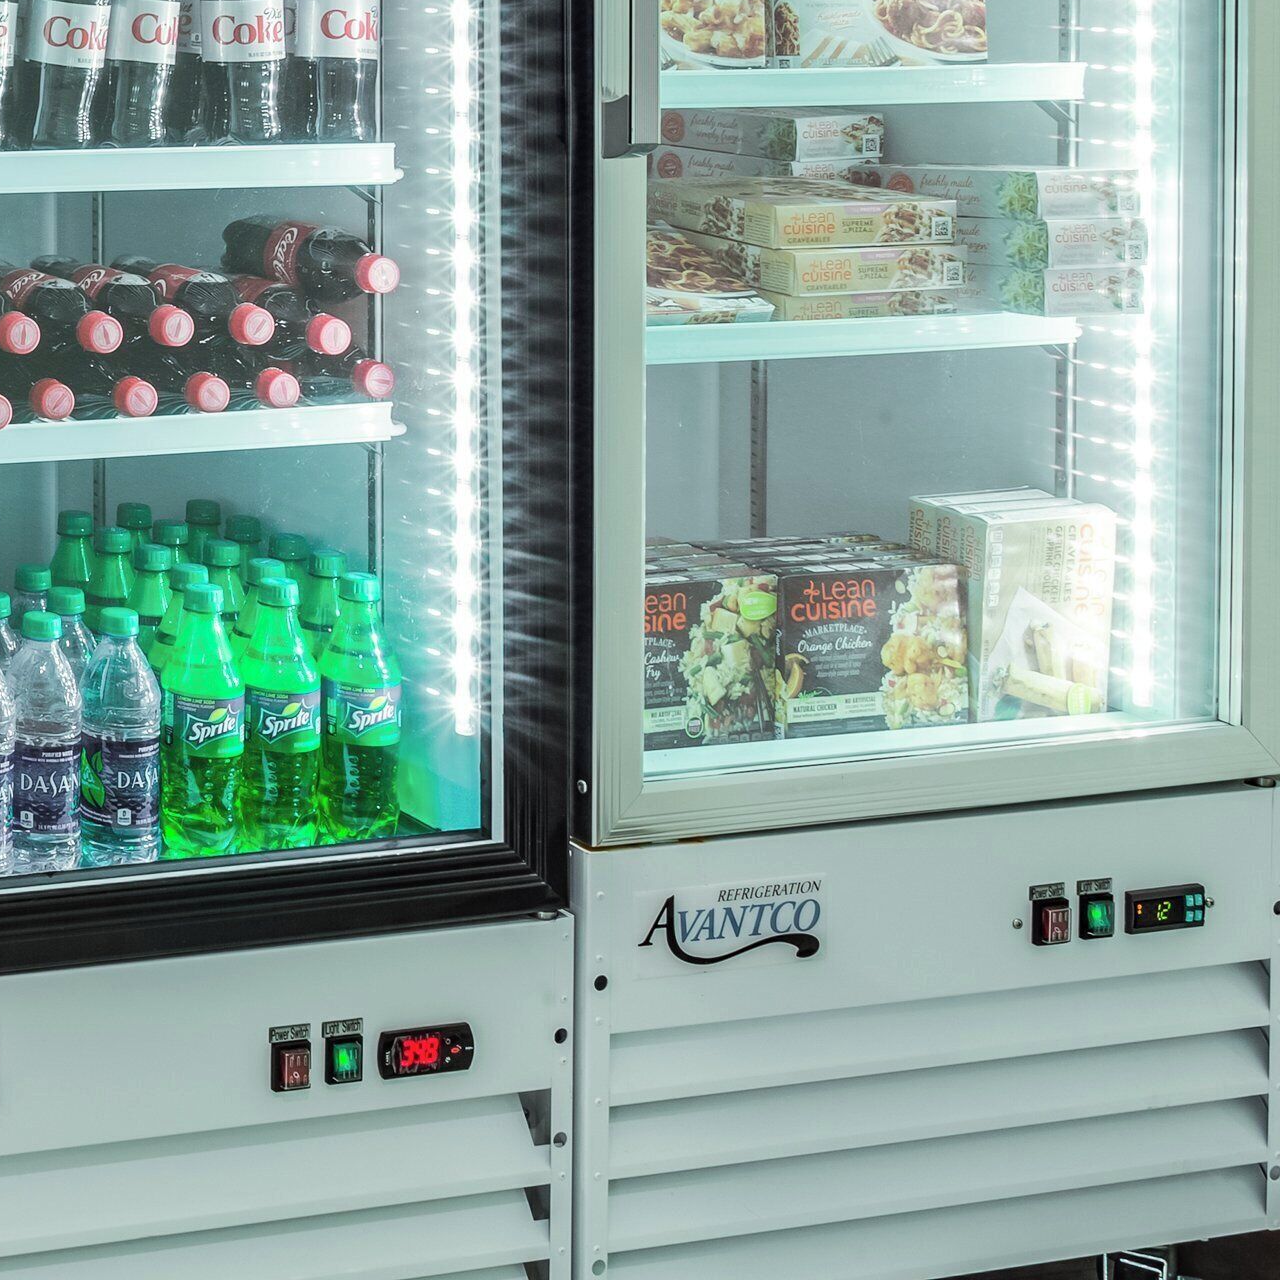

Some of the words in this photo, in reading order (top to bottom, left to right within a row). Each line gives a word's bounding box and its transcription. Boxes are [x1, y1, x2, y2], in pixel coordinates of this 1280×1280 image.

[212, 15, 284, 45] Coke
[803, 129, 839, 139] cuisine
[802, 211, 834, 223] Lean
[784, 223, 835, 235] cuisine
[1055, 233, 1097, 243] cuisine
[820, 259, 852, 269] Lean
[802, 272, 852, 283] cuisine
[791, 599, 877, 621] cuisine
[805, 624, 865, 637] MARKETPLACE
[797, 641, 832, 653] Orange
[835, 636, 872, 649] Chicken
[793, 704, 816, 713] NATURAL
[817, 703, 837, 711] CHICKEN
[262, 711, 311, 736] Sprite
[717, 879, 822, 904] REFRIGERATION
[1032, 888, 1048, 898] Power
[1048, 885, 1064, 896] Switch
[638, 894, 821, 964] AVANTCO
[271, 1027, 289, 1041] Power
[290, 1024, 310, 1038] Switch
[324, 1022, 339, 1036] Light
[341, 1019, 361, 1033] Switch
